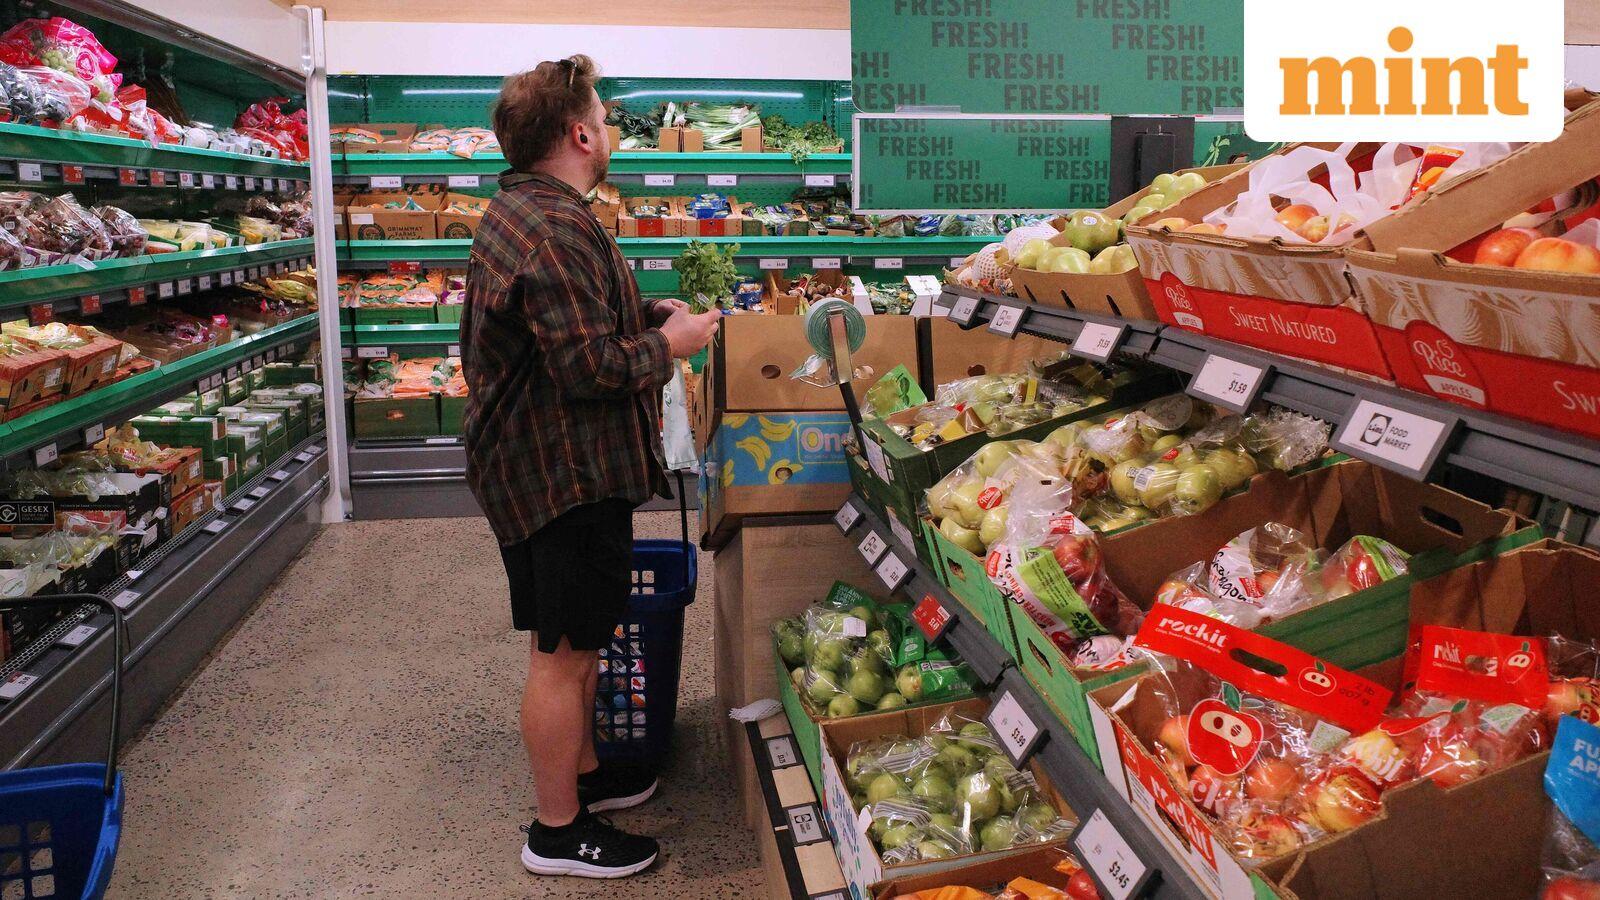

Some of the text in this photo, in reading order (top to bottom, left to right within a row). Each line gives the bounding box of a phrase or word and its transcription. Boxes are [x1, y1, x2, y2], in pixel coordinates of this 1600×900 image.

[895, 0, 991, 16] FRESH!
[1076, 0, 1170, 19] FRESH!
[931, 22, 1028, 48] FRESH!
[1112, 24, 1205, 51] FRESH!
[968, 53, 1064, 79] FRESH!
[1147, 55, 1239, 82] FRESH!
[1004, 84, 1099, 110] FRESH!
[879, 136, 953, 157] FRESH!
[1018, 136, 1090, 157] FRESH!
[906, 160, 980, 180] FRESH!
[1044, 160, 1108, 180] FRESH
[933, 183, 1006, 203] FRESH!
[1069, 183, 1110, 203] FRE
[1228, 306, 1337, 345] SWEET NATURED
[1229, 380, 1248, 394] $1.59
[1440, 382, 1473, 399] APPLES
[1389, 426, 1409, 438] FOOD
[1384, 438, 1411, 451] MARKET
[21, 505, 49, 513] GESEX
[1158, 617, 1229, 648] rockit
[1011, 727, 1026, 748] $3.99
[1109, 861, 1130, 889] $3.45
